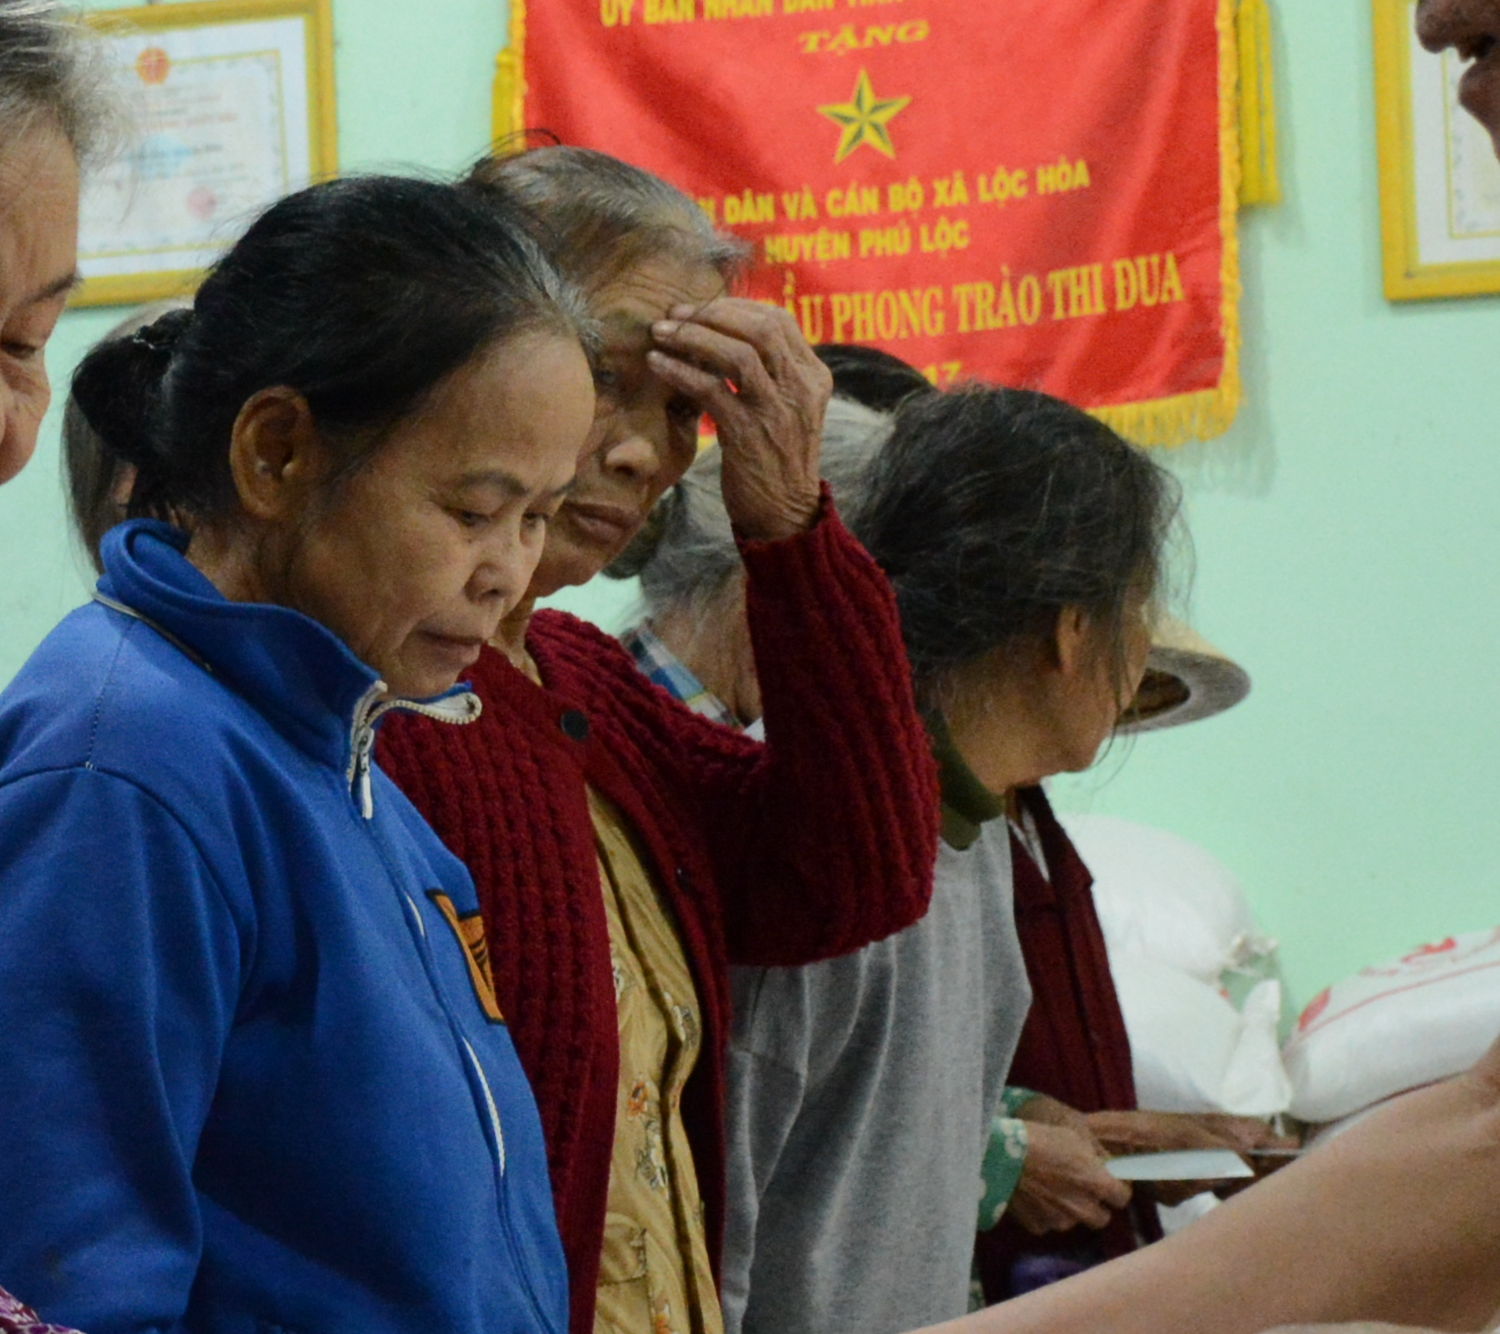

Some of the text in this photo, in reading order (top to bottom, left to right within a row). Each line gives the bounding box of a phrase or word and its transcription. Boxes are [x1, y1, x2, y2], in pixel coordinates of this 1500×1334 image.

[723, 187, 775, 224] DÂN
[782, 183, 817, 221] VÀ
[826, 179, 880, 218] CÁN
[888, 175, 925, 218] BỘ
[977, 165, 1029, 208] LỘC
[920, 215, 970, 259] LỘC
[829, 285, 946, 345] PHONG
[952, 263, 1043, 333] TRÀO
[1048, 261, 1107, 320] THI
[1114, 251, 1186, 312] ĐUA
